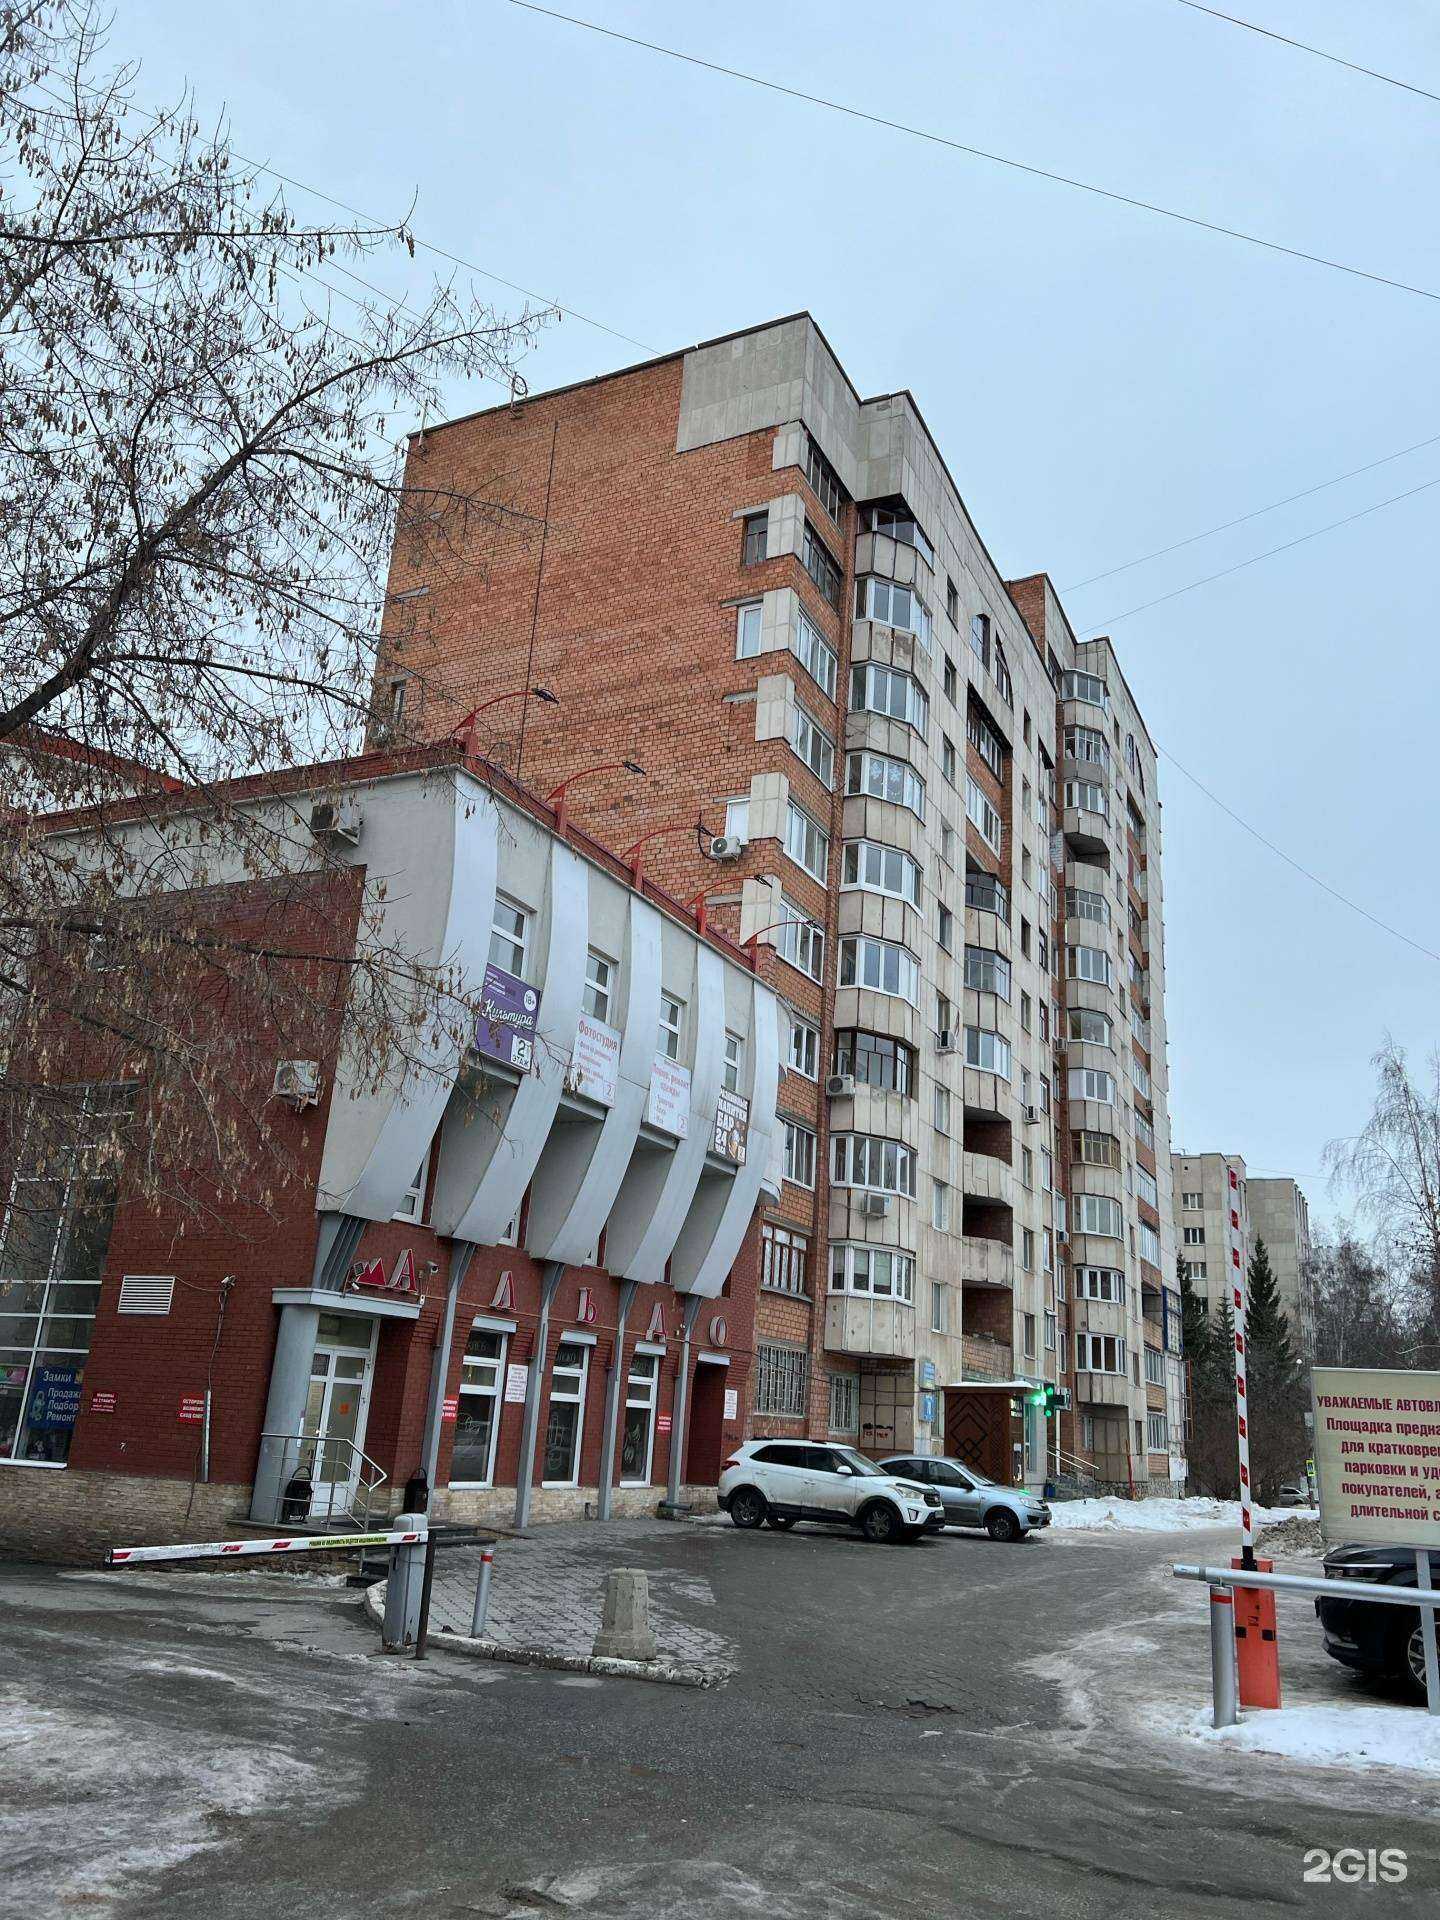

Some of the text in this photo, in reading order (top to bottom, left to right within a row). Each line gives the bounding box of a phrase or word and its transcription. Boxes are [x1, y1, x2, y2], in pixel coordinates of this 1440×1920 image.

[518, 1040, 526, 1058] 2
[43, 1370, 72, 1383] Замки
[47, 1400, 79, 1412] Подбор
[1317, 1395, 1393, 1411] УВАЖАЕМЫЕ
[46, 1411, 76, 1422] Ремонт
[1326, 1417, 1392, 1435] Площадка
[1341, 1441, 1365, 1454] для
[1344, 1462, 1440, 1480] парковки и уд
[1342, 1483, 1431, 1501] покупателей,
[1350, 1504, 1429, 1520] длительной
